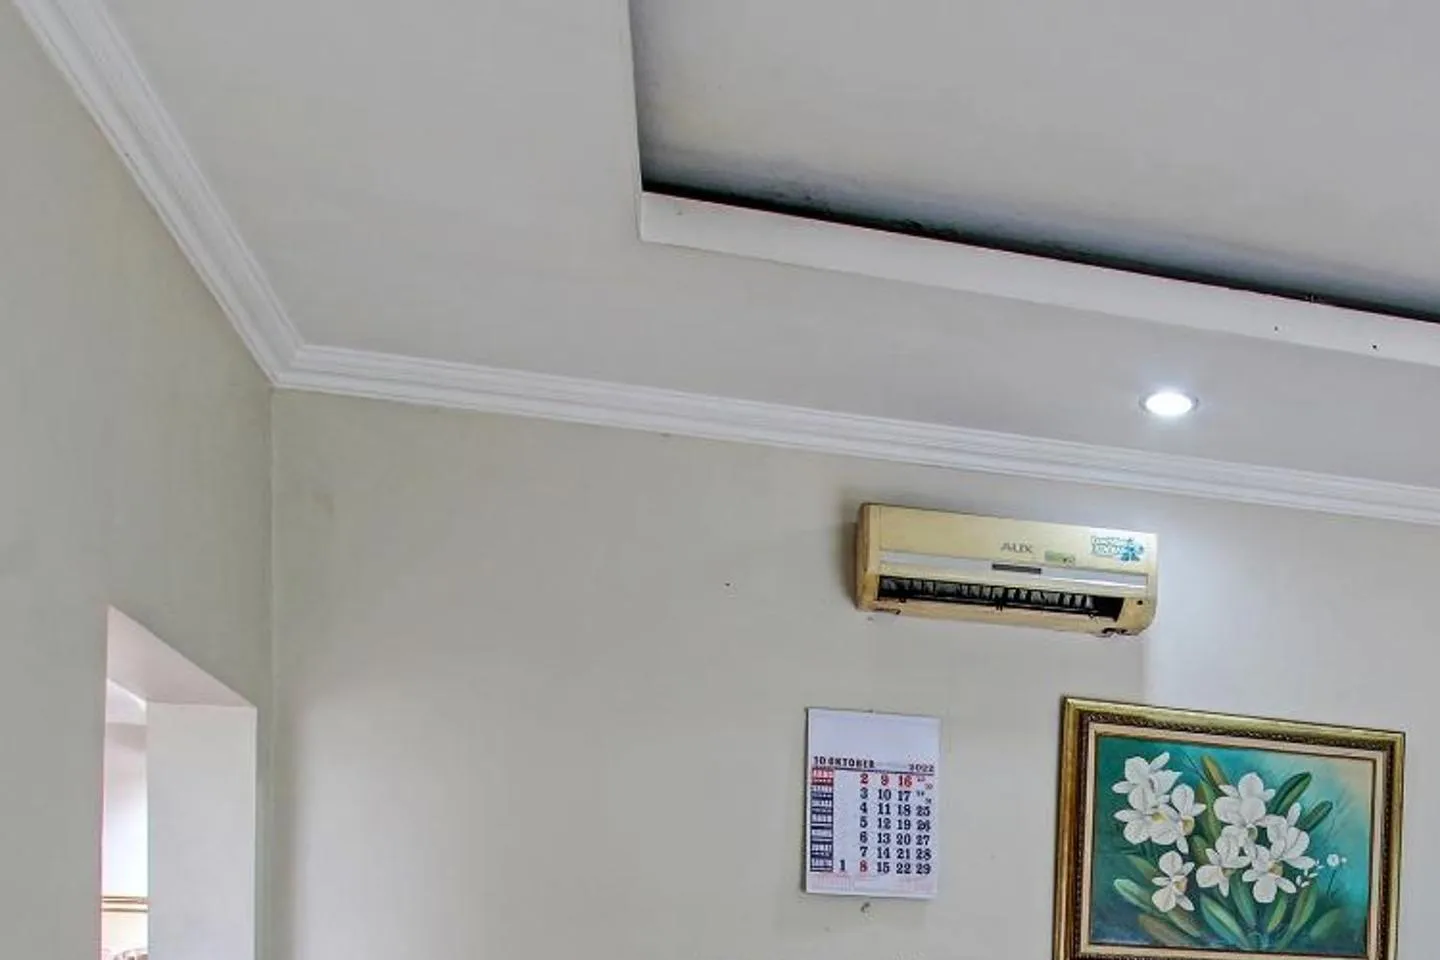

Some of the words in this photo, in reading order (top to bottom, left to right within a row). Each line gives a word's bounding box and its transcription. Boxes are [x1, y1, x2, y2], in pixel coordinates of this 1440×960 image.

[860, 773, 869, 785] 2
[880, 774, 889, 786] 9
[898, 775, 912, 787] 16
[860, 787, 869, 799] 3
[878, 789, 892, 800] 10
[898, 790, 911, 802] 17
[860, 802, 868, 814] 4
[877, 803, 891, 815] 11
[898, 804, 912, 816] 18
[916, 806, 931, 817] 25
[860, 816, 868, 829] 5
[878, 818, 891, 829] 12
[897, 819, 912, 830] 19
[860, 831, 868, 844] 6
[877, 833, 891, 844] 13
[896, 833, 912, 846] 20
[916, 835, 930, 846] 27
[860, 846, 868, 857] 7
[877, 847, 890, 859] 14
[896, 848, 911, 859] 21
[916, 848, 932, 861] 28
[840, 859, 846, 871] 1
[860, 860, 868, 872] 8
[877, 861, 890, 874] 15
[896, 862, 911, 874] 22
[916, 863, 932, 874] 29
